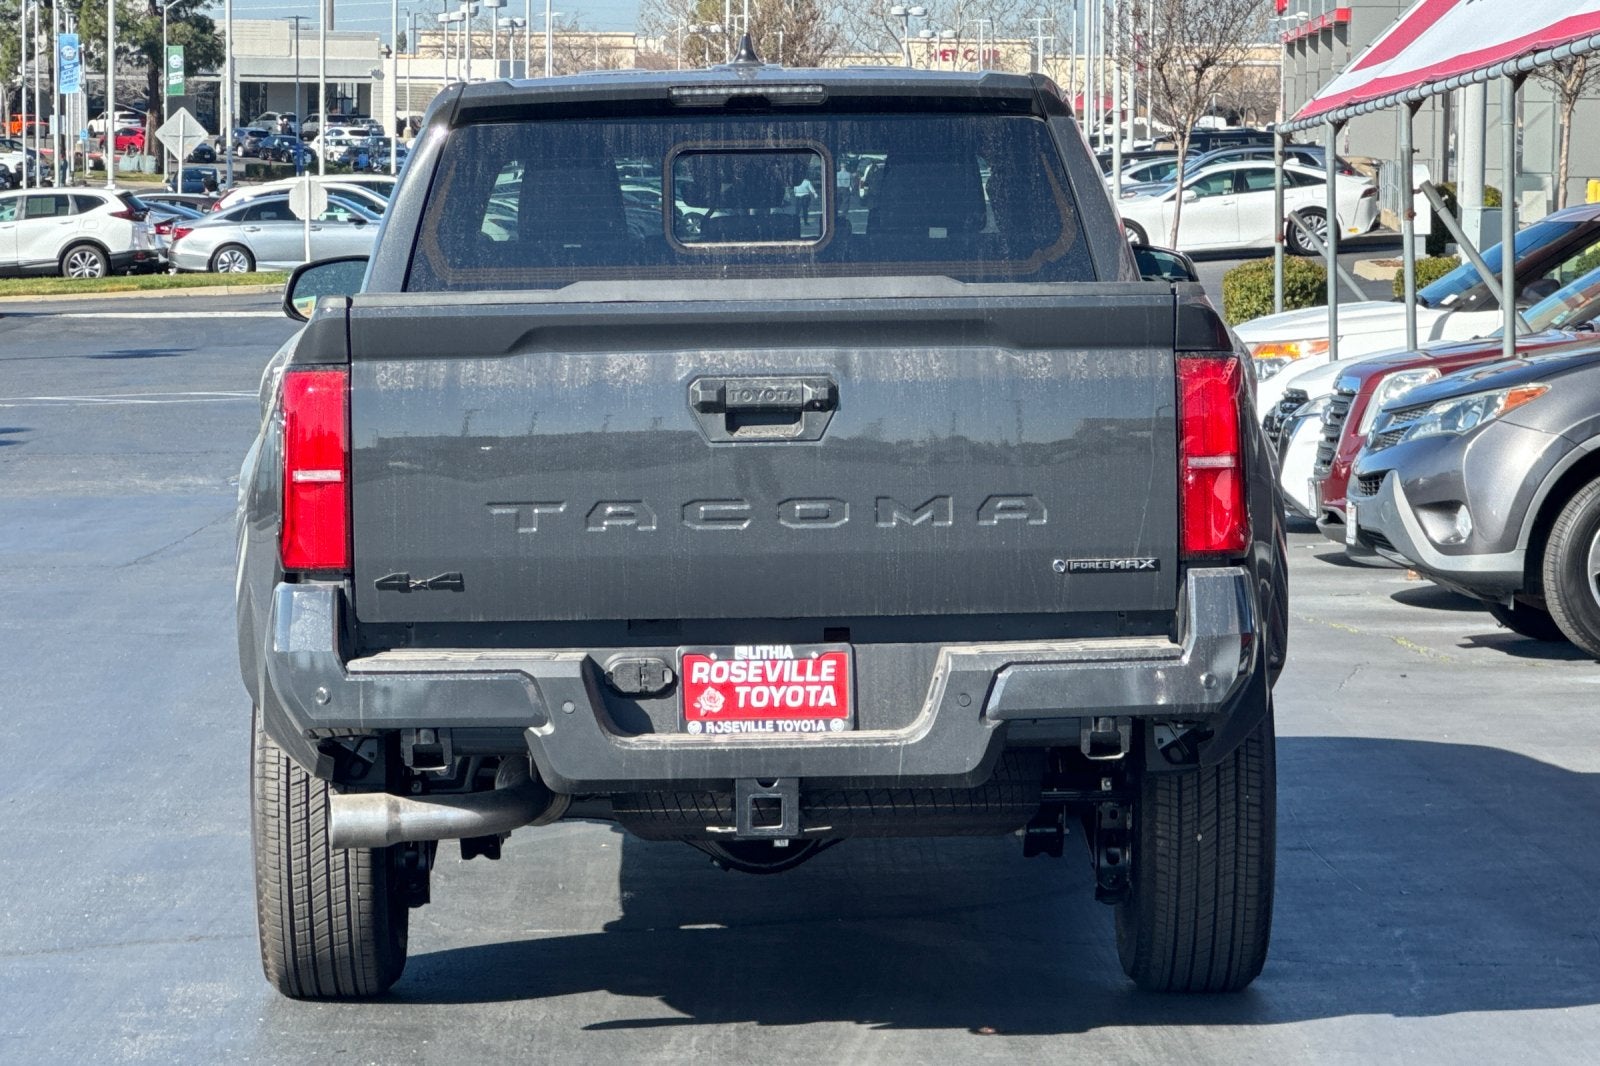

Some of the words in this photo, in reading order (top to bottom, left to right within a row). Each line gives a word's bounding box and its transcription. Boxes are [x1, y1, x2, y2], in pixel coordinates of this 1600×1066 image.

[730, 388, 798, 402] TOYOTA
[486, 494, 1049, 532] TACOMA
[748, 645, 794, 660] LITHIA
[691, 660, 836, 684] ROSEVILLE
[736, 685, 837, 708] TOYOTA
[706, 719, 775, 734] ROSEVILLE
